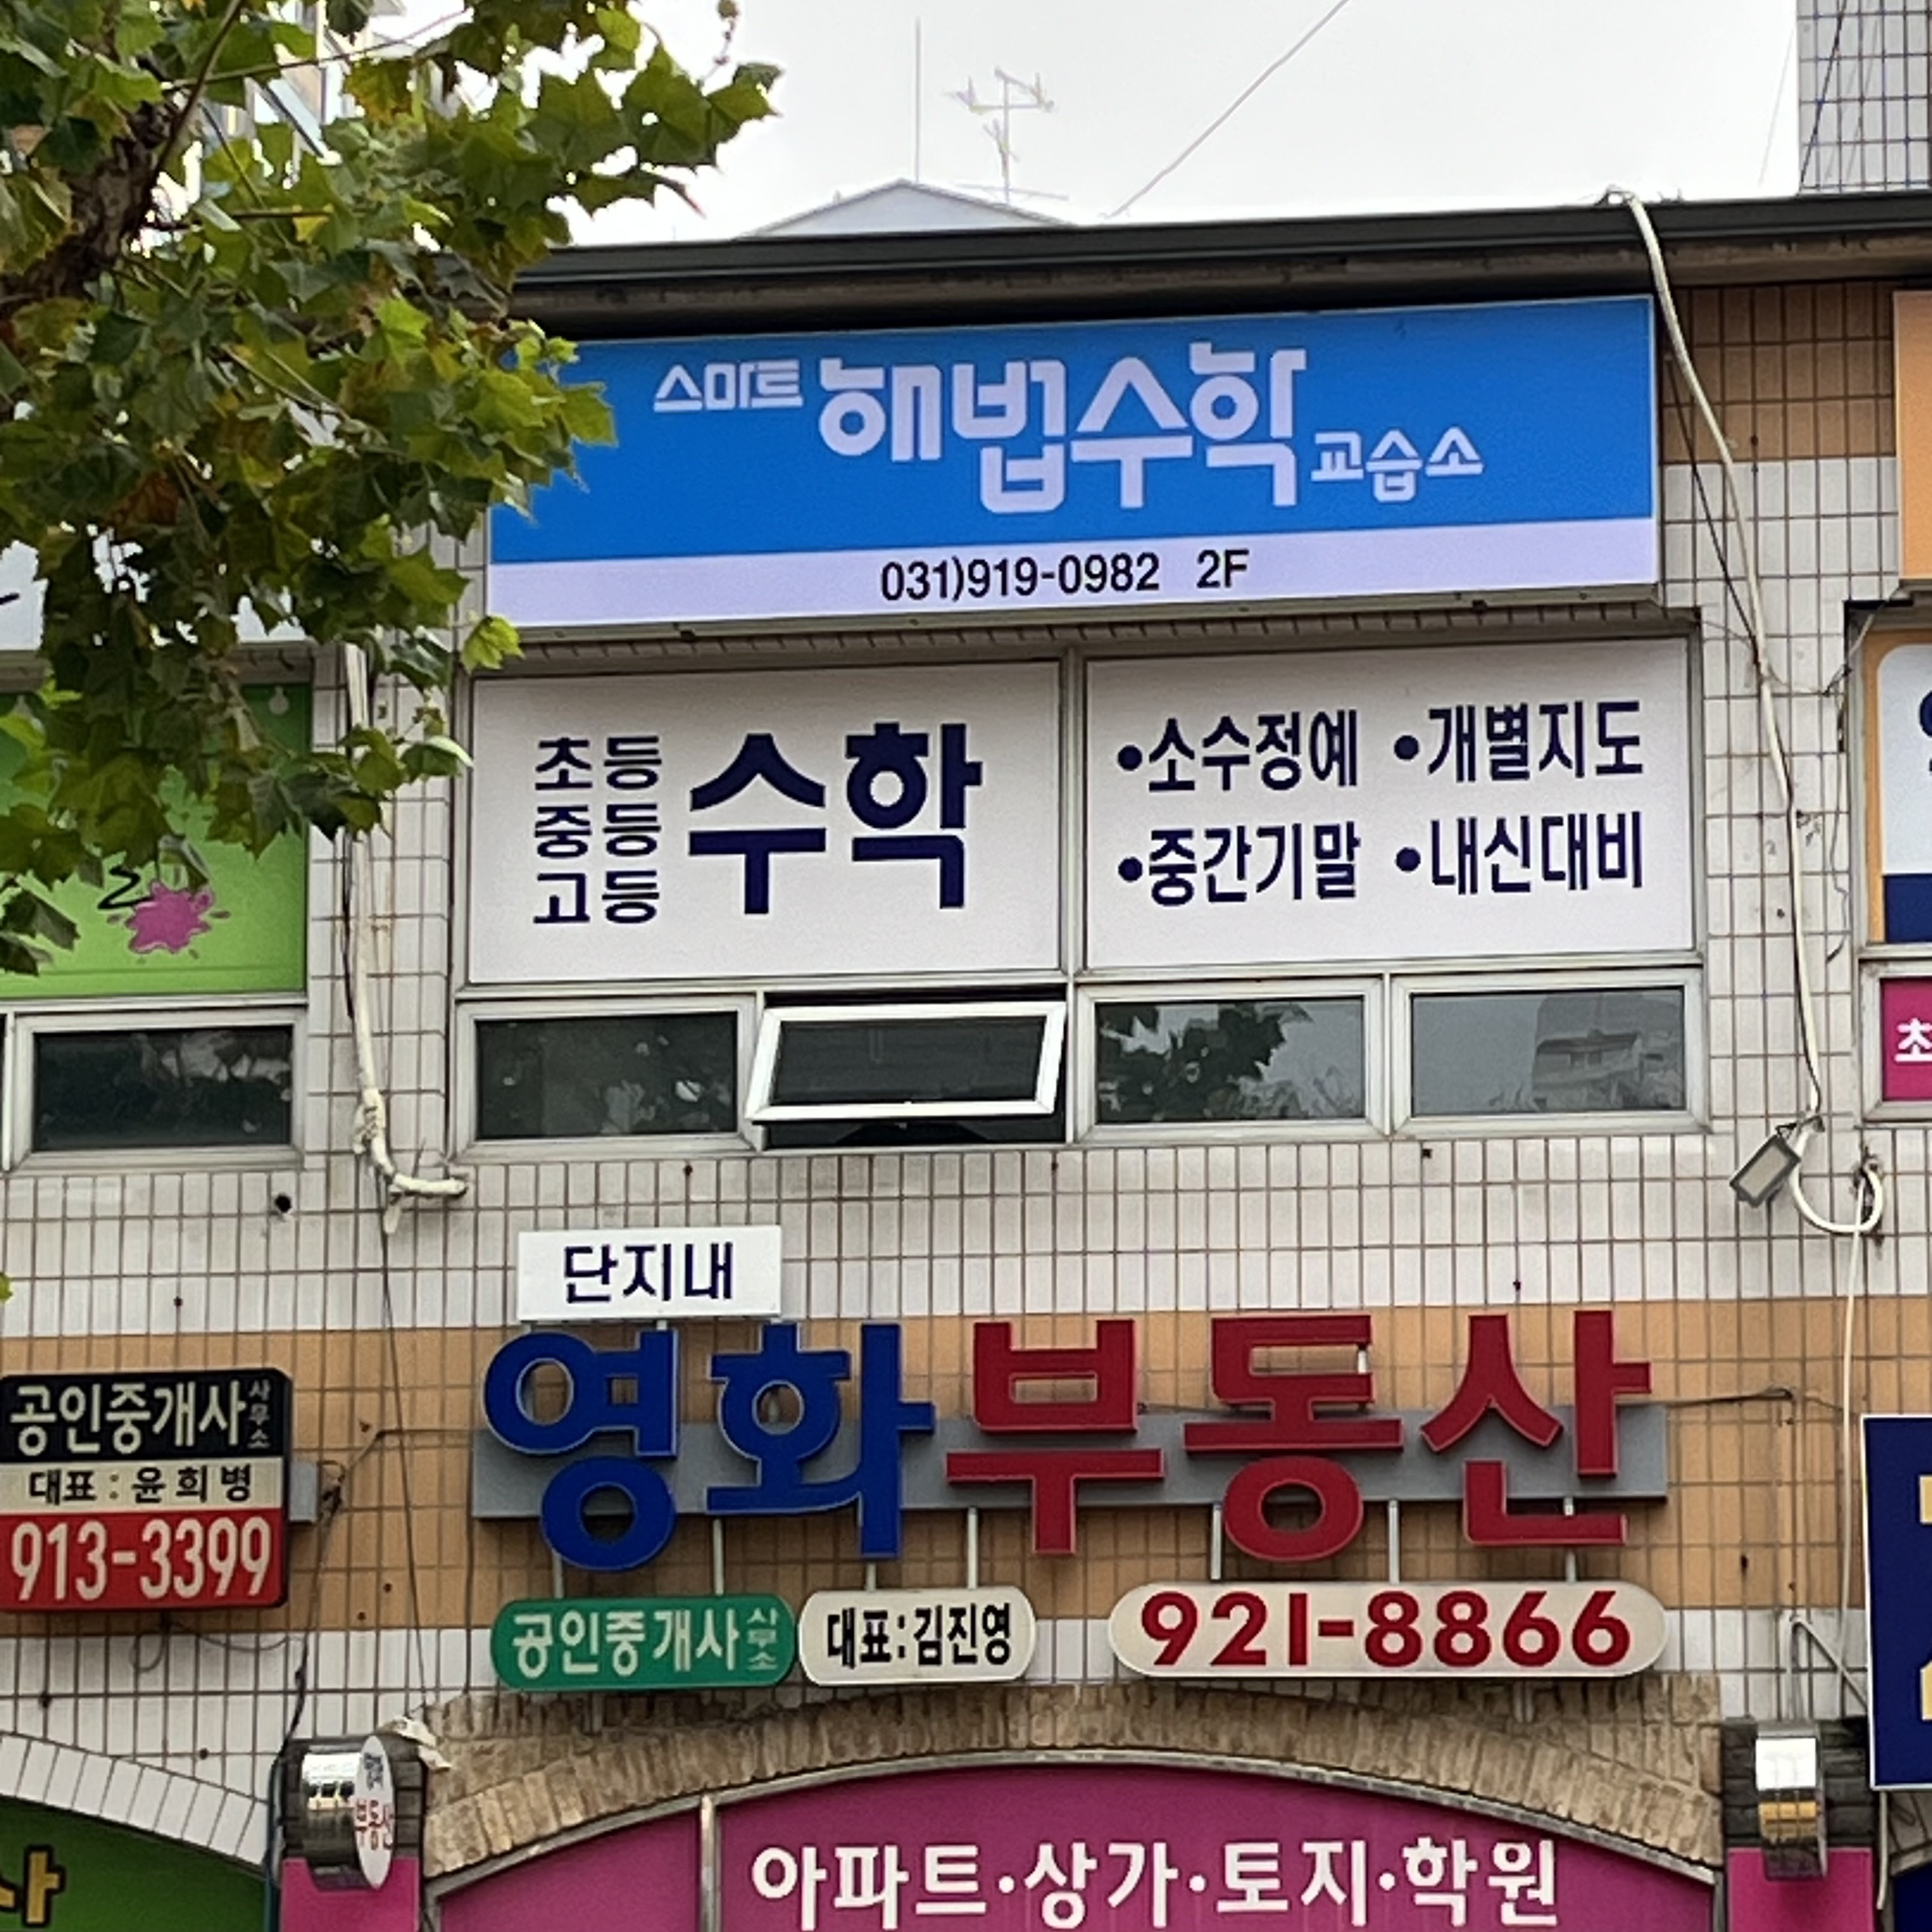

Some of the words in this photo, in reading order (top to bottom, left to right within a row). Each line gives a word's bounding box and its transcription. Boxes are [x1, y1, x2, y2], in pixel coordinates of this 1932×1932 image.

[654, 358, 803, 412] 스마트
[818, 342, 1307, 514] 해법수학
[1311, 426, 1484, 503] 교습소
[880, 552, 1160, 602] 031)919-0982
[1196, 549, 1250, 589] 2F
[535, 735, 662, 792] 초등
[1148, 709, 1359, 792] 소수정예
[1428, 700, 1643, 783] 개별지도
[534, 803, 662, 859] 중등
[689, 721, 983, 915] 수학
[533, 870, 661, 924] 고등
[1149, 820, 1361, 907] 중간기말
[1431, 811, 1643, 895] 내신대비
[564, 1241, 734, 1305] 단지내
[10, 1380, 247, 1456] 공인중개사
[11, 1516, 272, 1601] 913-3399
[513, 1608, 740, 1678] 공인중개사
[1141, 1590, 1631, 1667] 921-8866
